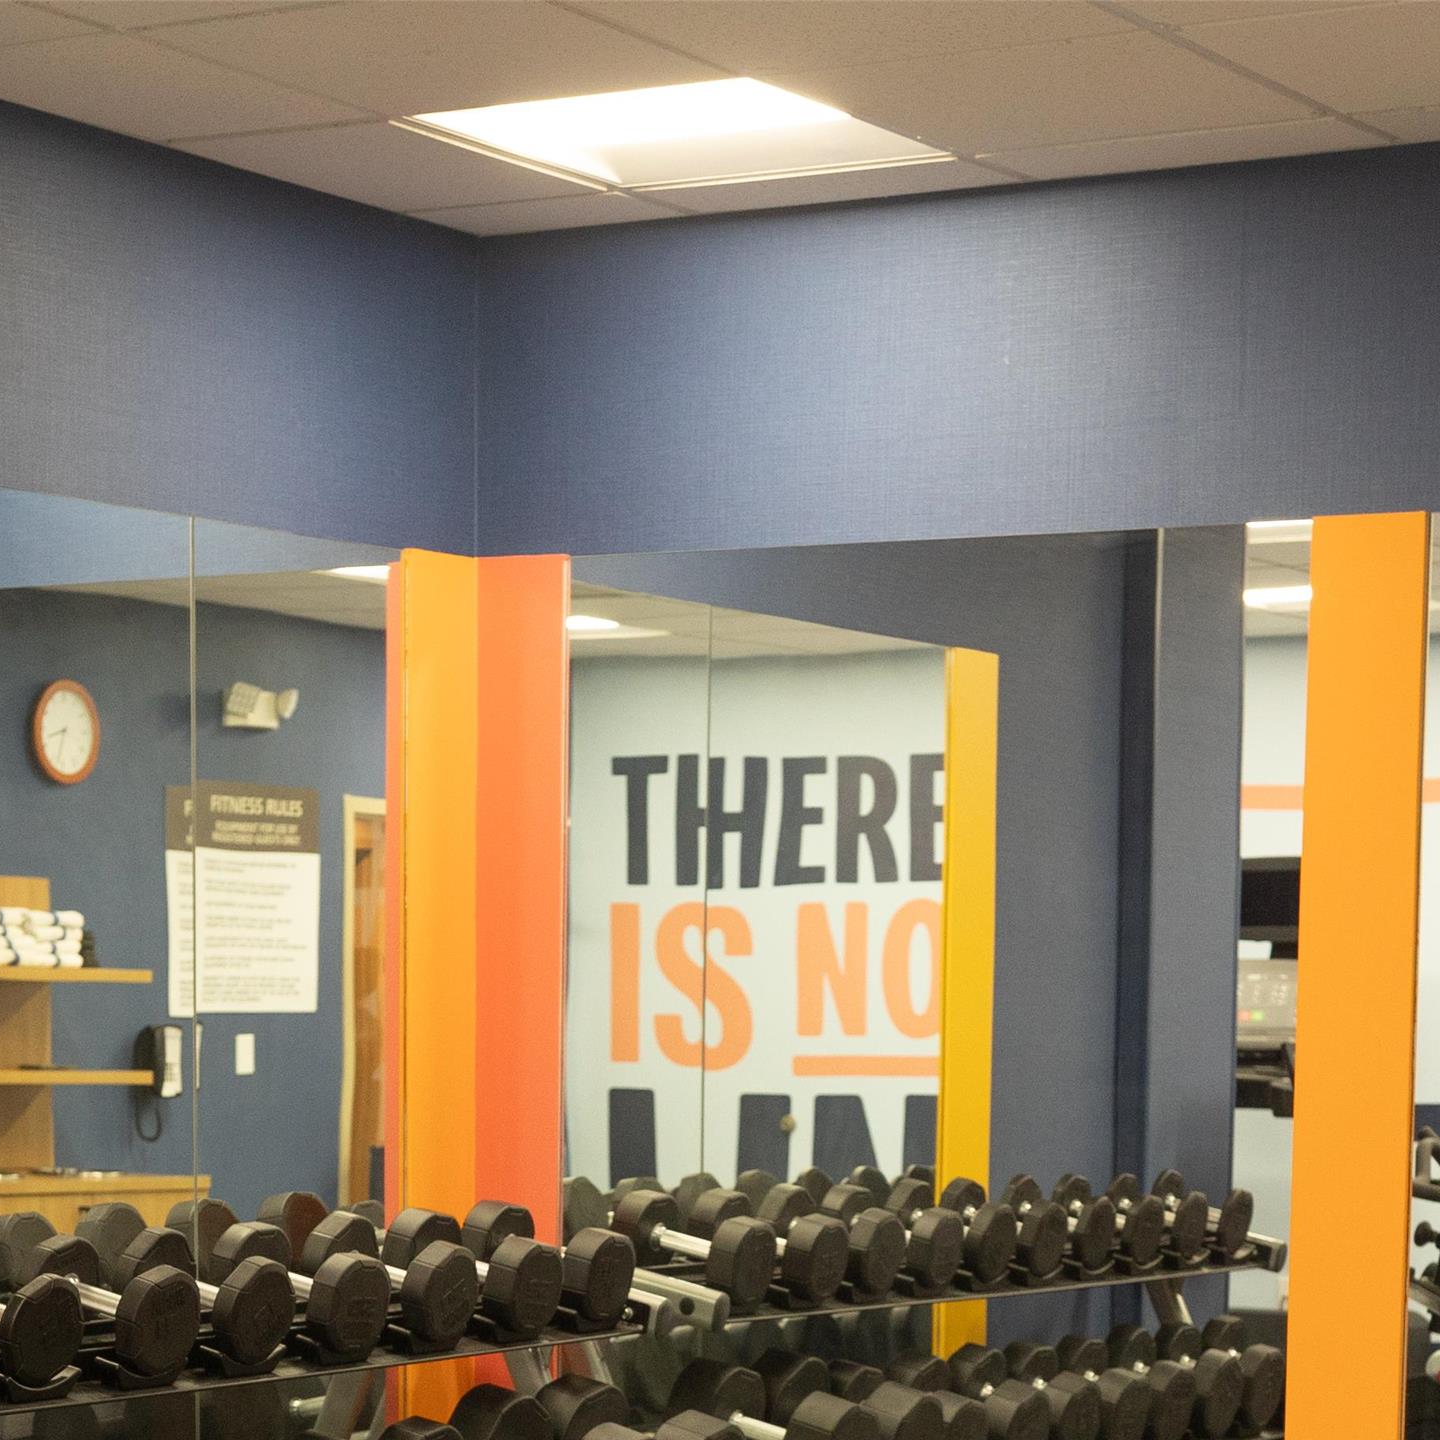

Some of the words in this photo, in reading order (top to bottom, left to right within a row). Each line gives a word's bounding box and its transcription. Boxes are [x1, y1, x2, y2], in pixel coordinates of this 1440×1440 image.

[210, 794, 264, 816] FITNESS
[265, 797, 304, 818] RULES
[612, 753, 945, 890] THERE
[610, 902, 753, 1071] IS
[796, 898, 944, 1040] NO
